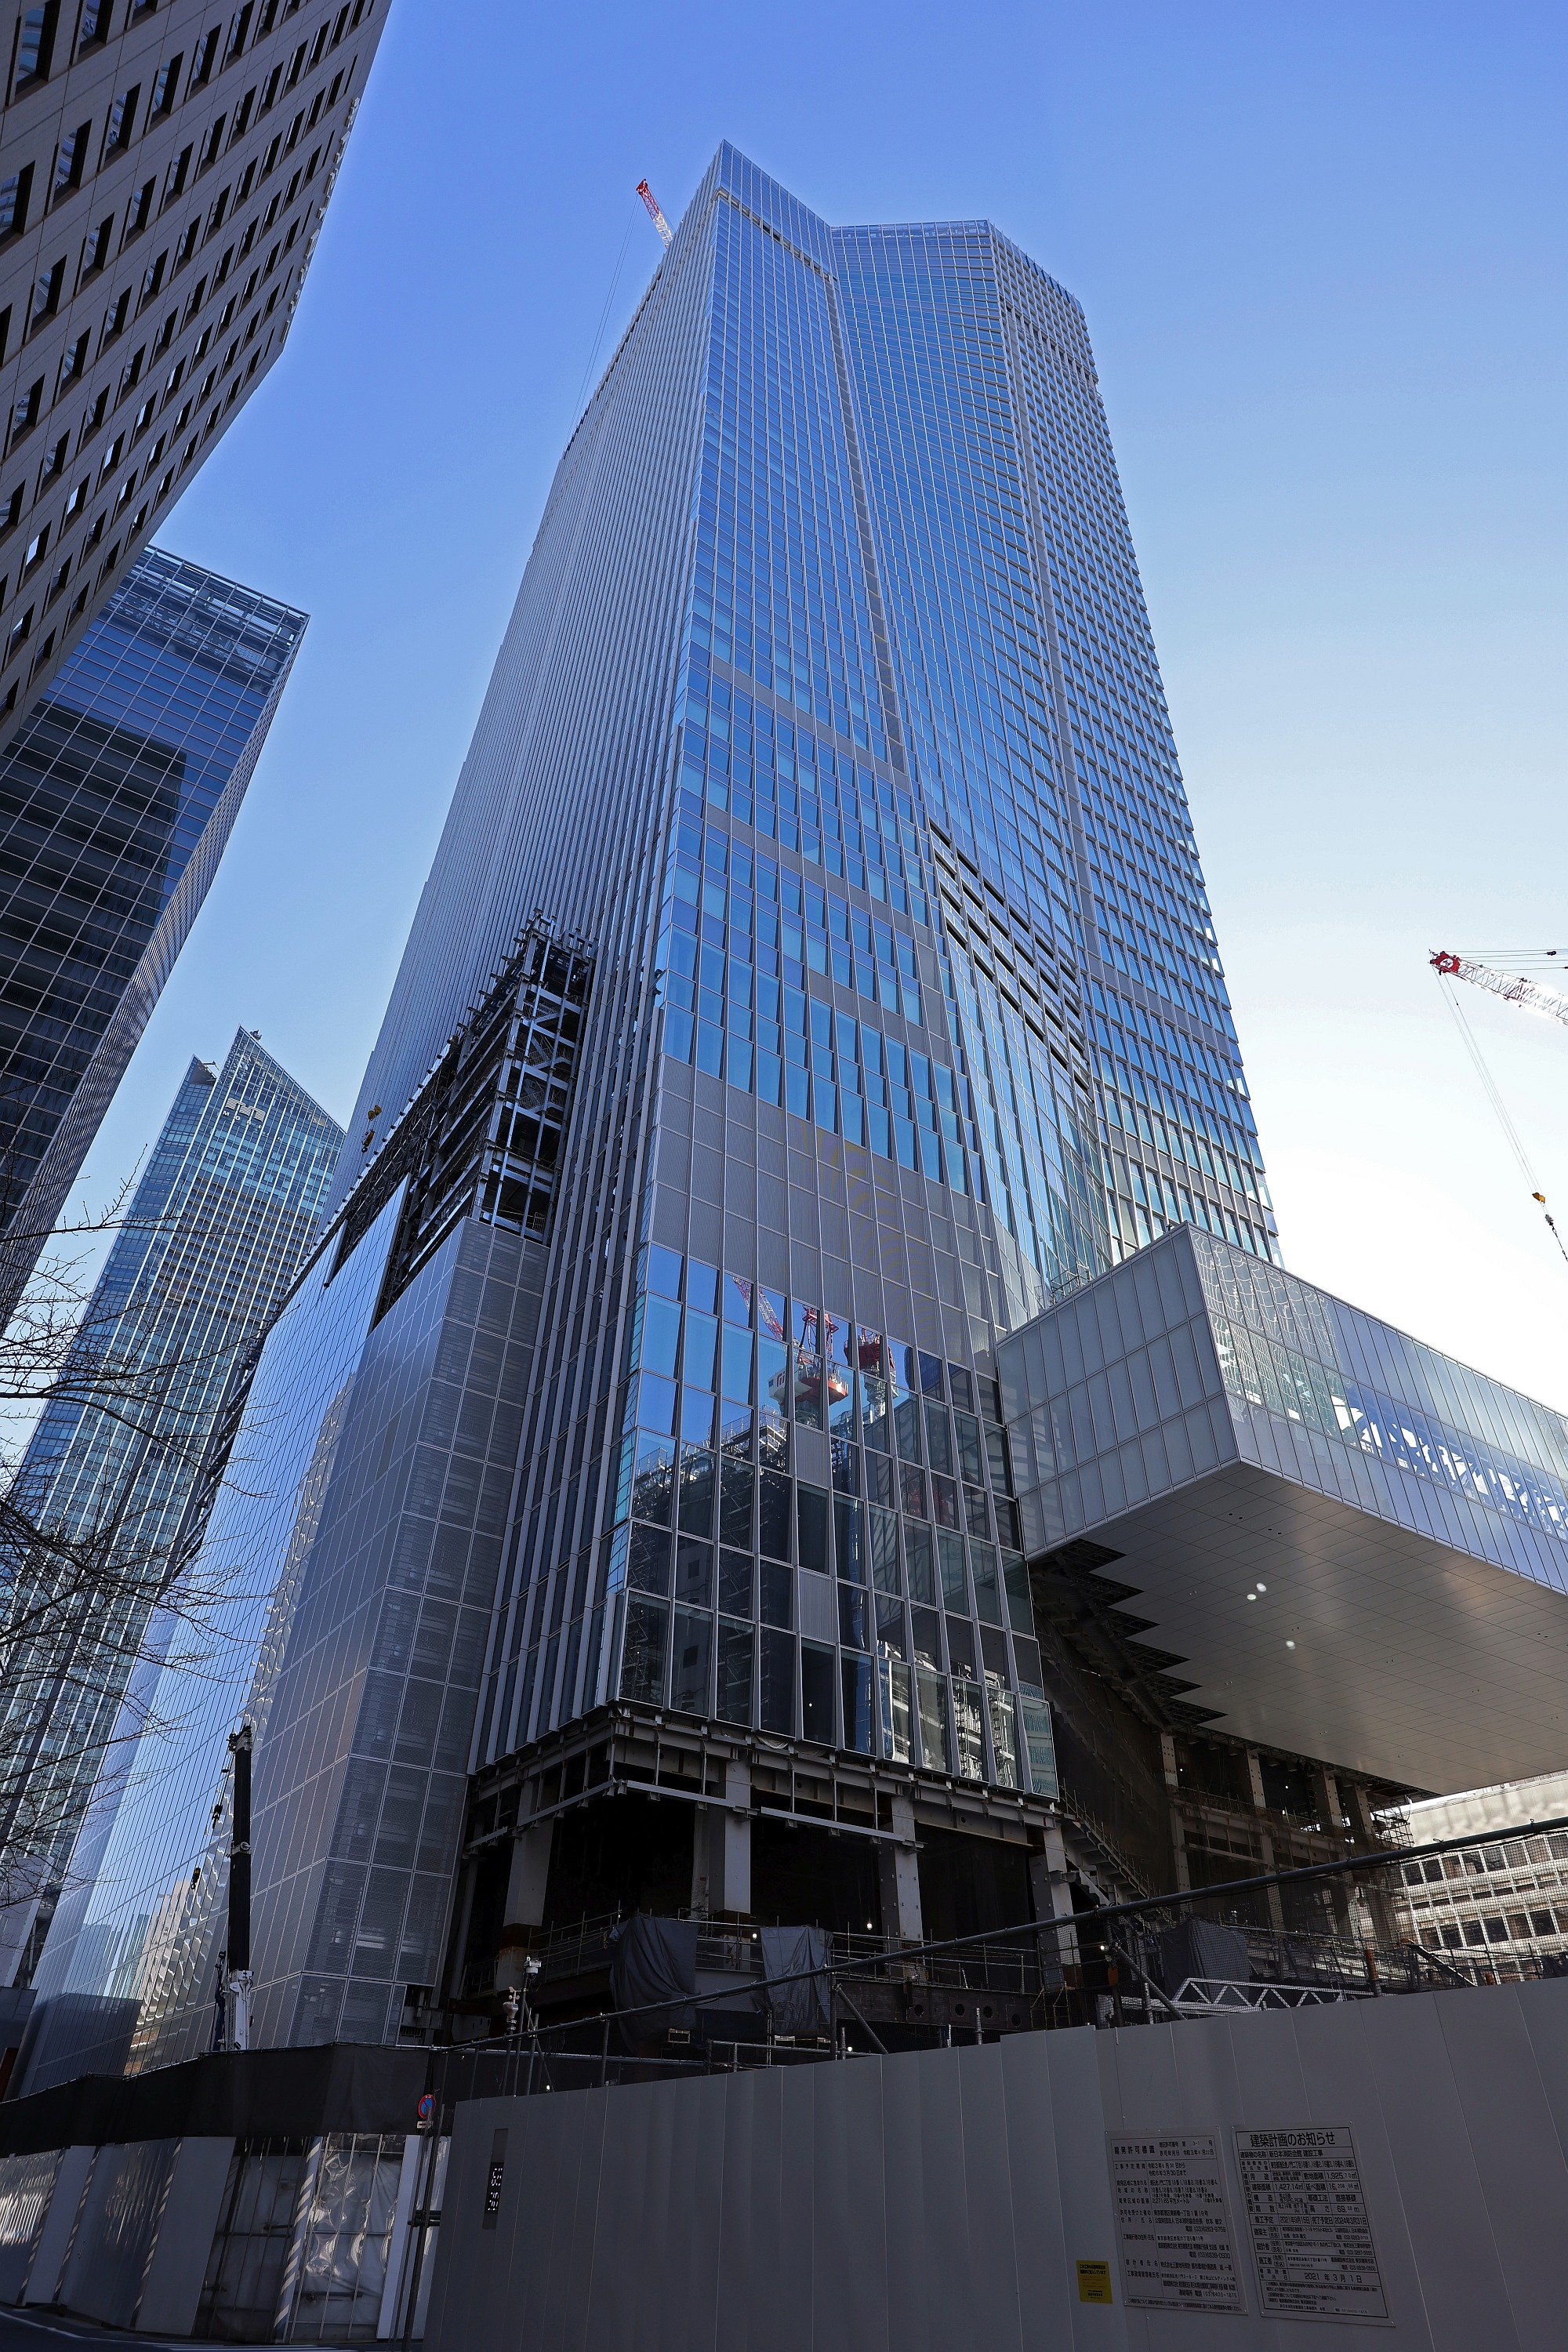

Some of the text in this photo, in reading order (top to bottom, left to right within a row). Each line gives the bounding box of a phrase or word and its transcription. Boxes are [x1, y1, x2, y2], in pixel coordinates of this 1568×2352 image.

[223, 1110, 260, 1129] MORI
[1250, 2132, 1335, 2147] 建築計画のお知らせ
